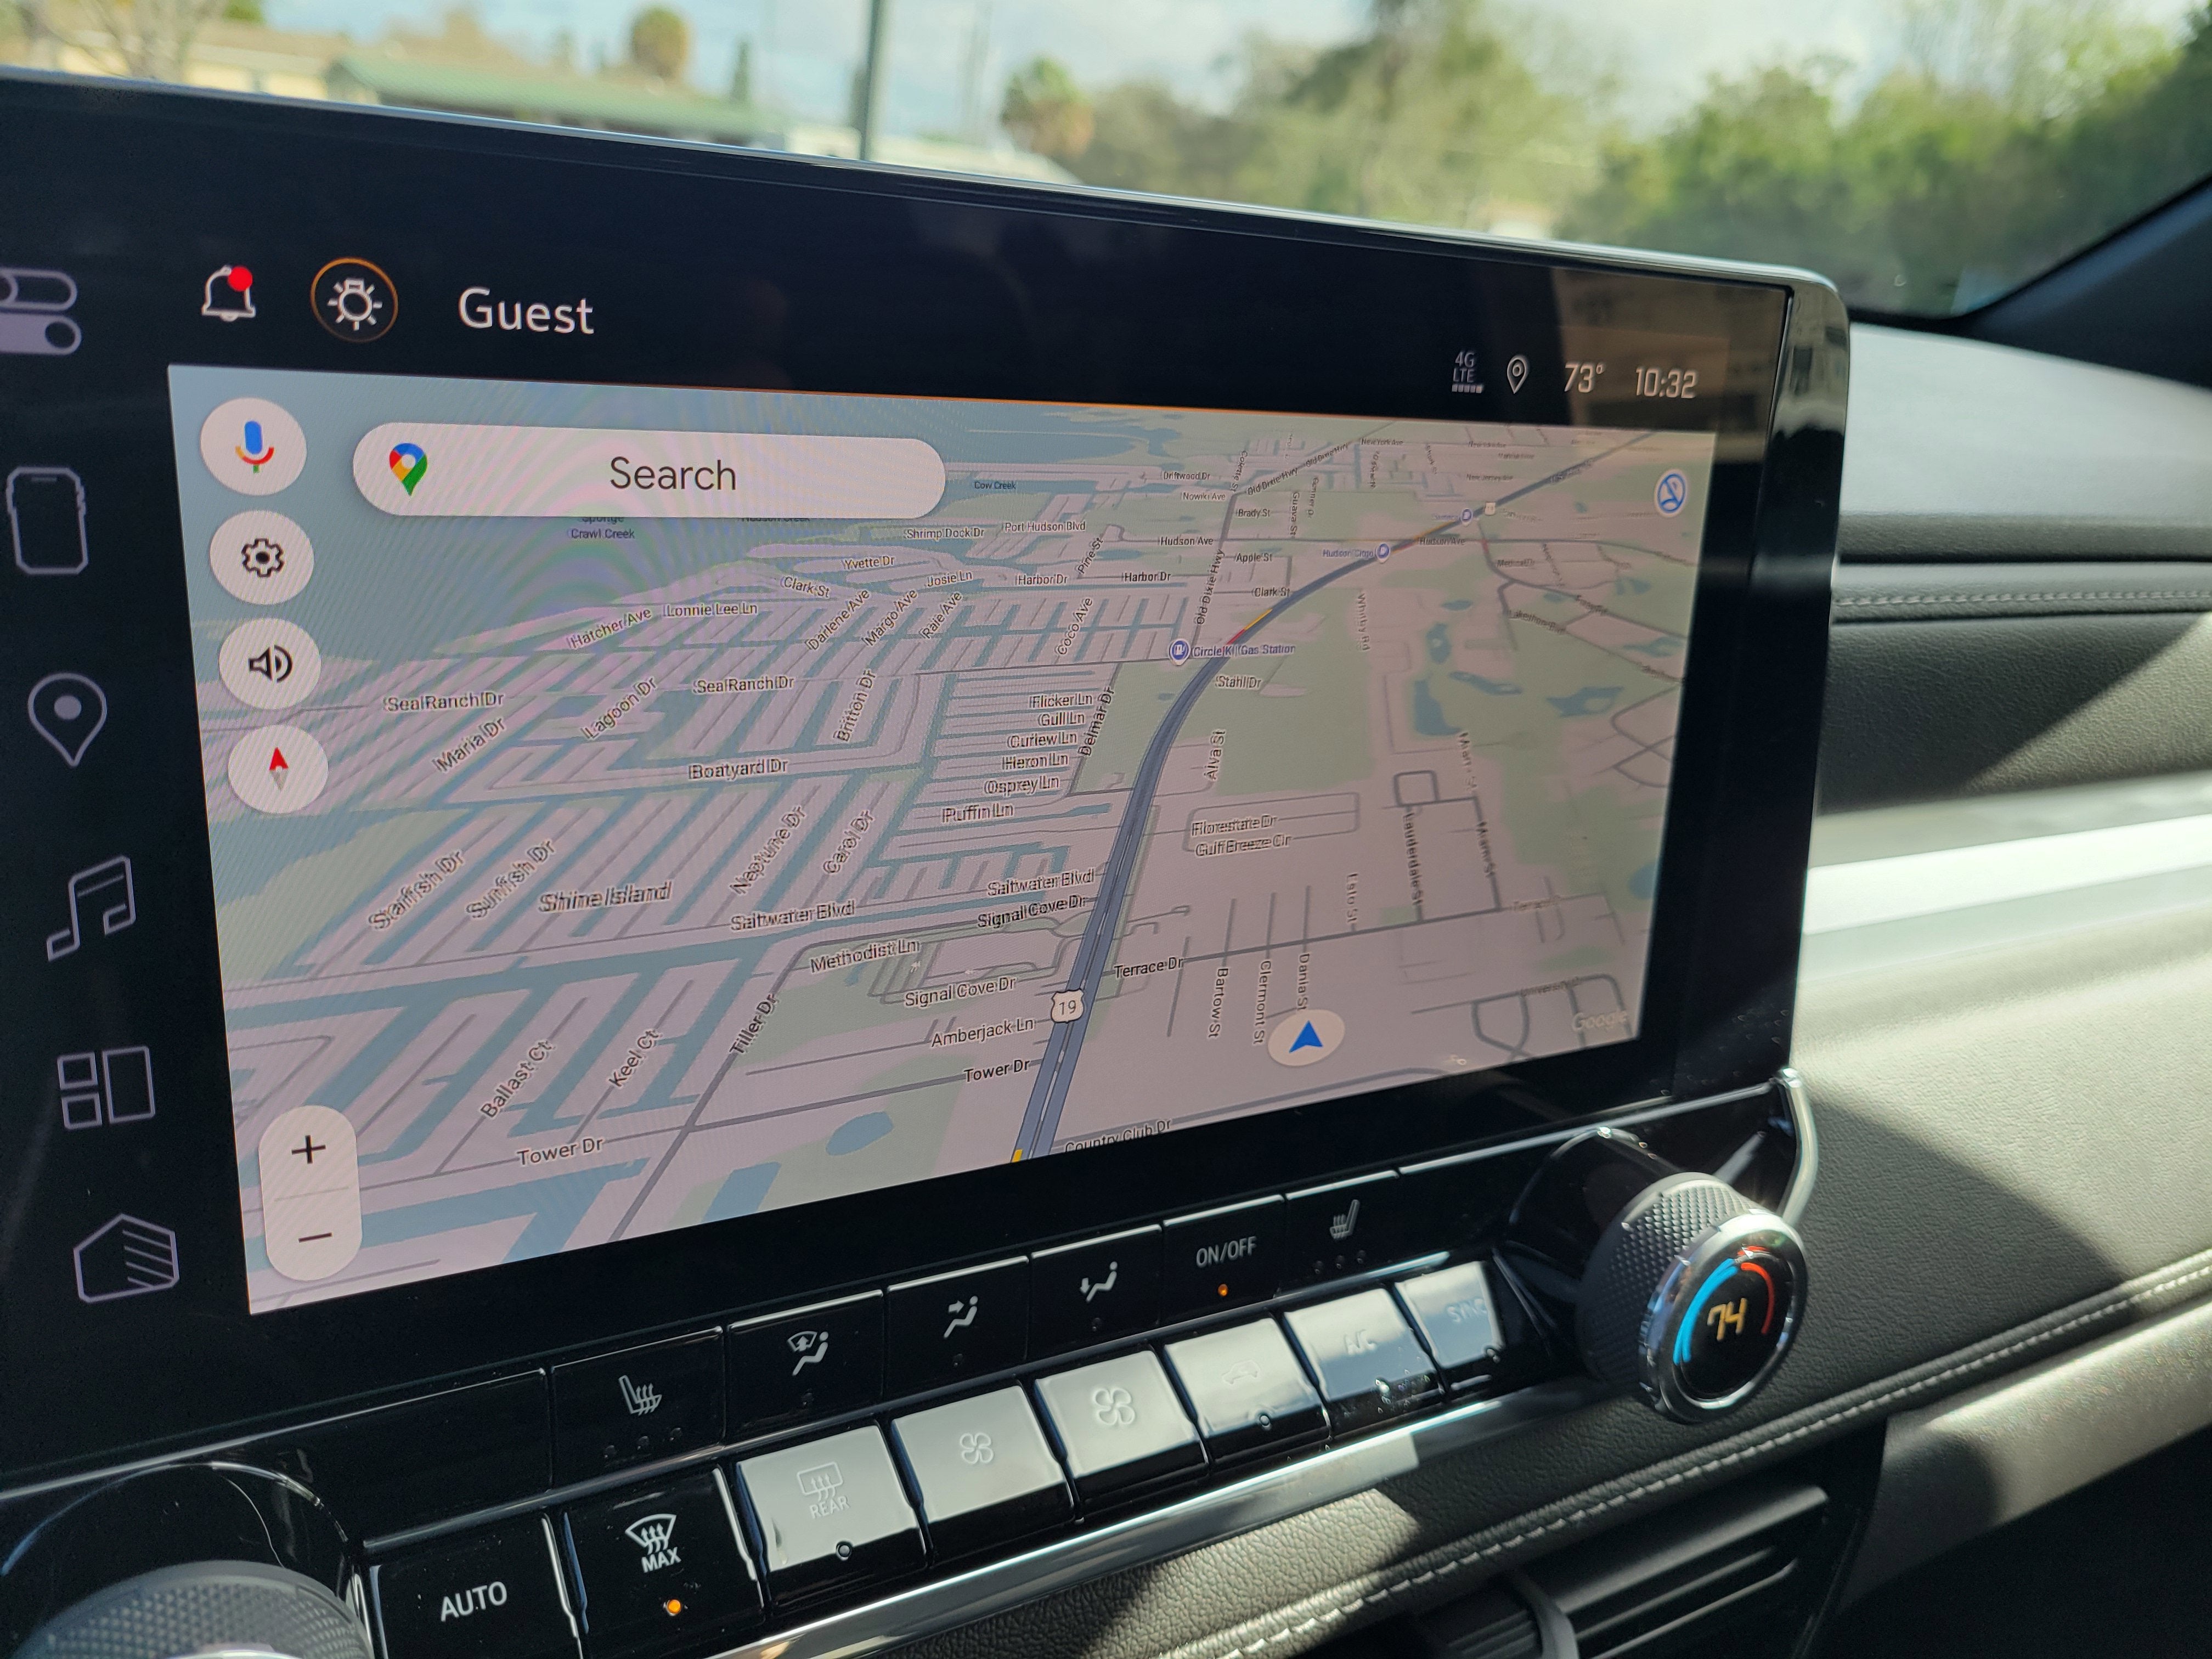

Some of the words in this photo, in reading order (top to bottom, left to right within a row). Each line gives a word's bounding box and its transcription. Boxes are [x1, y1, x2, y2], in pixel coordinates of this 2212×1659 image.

[459, 287, 594, 335] Guest
[1455, 351, 1475, 366] 4G
[1453, 368, 1475, 383] LTE
[1635, 366, 1698, 399] 10:32
[610, 456, 736, 490] Search
[1163, 472, 1200, 481] Driftwood
[1248, 486, 1261, 495] Old
[1262, 476, 1280, 490] Dixie
[1282, 467, 1299, 481] Hwy
[994, 481, 1016, 489] Creek
[1238, 509, 1260, 518] Brady
[1290, 492, 1300, 522] Guava
[571, 528, 601, 539] Crawl
[605, 528, 635, 539] Creek
[907, 528, 942, 539] Shrimp
[945, 528, 971, 538] Dock
[974, 528, 985, 537] Dr
[1006, 523, 1024, 532] Port
[1028, 522, 1063, 532] Hudson
[1066, 522, 1086, 531] Blvd
[1290, 526, 1297, 536] St
[1161, 537, 1195, 546] Hudson
[1197, 537, 1214, 545] Ave
[845, 557, 880, 569] Yvette
[883, 555, 895, 567] Dr
[1077, 550, 1096, 574] Pine
[1093, 537, 1104, 551] St
[1209, 549, 1226, 574] Hwy
[1236, 554, 1260, 563] Apple
[1262, 553, 1272, 562] St
[784, 576, 814, 594] Clark
[816, 585, 831, 597] St
[927, 573, 957, 587] Josie
[959, 571, 972, 582] Ln
[1018, 574, 1052, 585] Harbor
[1056, 574, 1068, 585] Dr
[1125, 572, 1158, 582] Harbor
[1160, 571, 1171, 581] Dr
[1201, 576, 1216, 605] Dixie
[1254, 588, 1277, 597] Clark
[1280, 588, 1290, 596] St
[667, 604, 711, 617] Lonnie
[716, 604, 738, 616] Lee
[741, 604, 759, 615] Ln
[809, 605, 850, 651] Darlene
[848, 589, 871, 612] Ave
[866, 609, 898, 647] Margo
[895, 589, 918, 611] Ave
[1195, 606, 1208, 626] Old
[571, 620, 623, 650] Hatcher
[626, 607, 652, 625] Ave
[1057, 622, 1079, 656] Coco
[1075, 596, 1093, 623] Ave
[1193, 646, 1222, 657] Circle
[1224, 646, 1233, 656] K
[1240, 646, 1259, 656] Gas
[1262, 645, 1295, 655] Station
[729, 677, 772, 691] Ranch
[777, 675, 794, 689] Dr
[1218, 676, 1246, 689] Stahl
[1249, 677, 1262, 689] Dr
[425, 693, 479, 710] Ranch
[485, 692, 504, 706] Dr
[585, 693, 640, 741] Lagoon
[636, 677, 658, 698] Dr
[836, 691, 867, 742] Britton
[859, 670, 877, 690] Dr
[1032, 695, 1074, 708] Flicker
[1079, 693, 1092, 706] Ln
[1041, 714, 1066, 726] Gull
[1070, 713, 1085, 724] Ln
[437, 732, 487, 773] Maria
[483, 717, 506, 739] Dr
[1010, 733, 1058, 748] Curlew
[1062, 732, 1077, 743] Ln
[1211, 730, 1226, 746] St
[691, 759, 764, 782] Boatyard
[769, 758, 788, 772] Dr
[1005, 756, 1048, 770] Heron
[1052, 753, 1069, 766] Ln
[1206, 747, 1222, 781] Alva
[987, 780, 1037, 798] Osprey
[1042, 776, 1059, 789] Ln
[851, 809, 874, 832] Dr
[944, 805, 990, 822] Puffin
[994, 803, 1014, 817] Ln
[1262, 815, 1278, 828] Dr
[530, 839, 556, 864] Dr
[730, 828, 792, 896] Neptune
[781, 805, 806, 829] Dr
[1195, 840, 1226, 857] Gulf
[1227, 837, 1272, 853] Breeze
[1273, 834, 1291, 847] Cir
[437, 849, 465, 876] Dr
[988, 876, 1059, 897] Saltwater
[1062, 868, 1094, 887] Blvd
[538, 891, 602, 912] Shine
[606, 881, 672, 907] Island
[731, 909, 815, 931] Saltwater
[817, 900, 855, 920] Blvd
[978, 907, 1028, 929] Signal
[1029, 899, 1067, 917] Cove
[1069, 894, 1087, 909] Dr
[811, 944, 894, 974] Methodist
[898, 939, 921, 954] Ln
[1114, 961, 1164, 979] Terrace
[1168, 957, 1184, 970] Dr
[905, 986, 953, 1008] Signal
[957, 980, 995, 998] Cove
[998, 977, 1017, 992] Dr
[1211, 967, 1229, 1021] Bartow
[1255, 960, 1273, 1027] Clermont
[1058, 1000, 1076, 1016] 19
[1297, 997, 1309, 1012] St
[730, 1017, 765, 1054] Tiller
[757, 992, 780, 1015] Dr
[931, 1020, 1011, 1048] Amberjack
[1017, 1019, 1034, 1032] Ln
[1208, 1023, 1221, 1039] St
[1253, 1029, 1266, 1046] St
[609, 1051, 642, 1088] Keel
[637, 1029, 659, 1051] Ct
[481, 1062, 533, 1119] Ballast
[529, 1040, 555, 1063] Ct
[964, 1064, 1010, 1082] Tower
[1013, 1059, 1031, 1073] Dr
[1123, 1124, 1153, 1141] Club
[1156, 1119, 1172, 1132] Dr
[517, 1142, 577, 1166] Tower
[582, 1137, 604, 1154] Dr
[1196, 1236, 1257, 1268] ON/OFF
[1707, 1297, 1747, 1341] 74
[810, 1495, 851, 1519] REAR
[641, 1547, 682, 1573] MAX
[441, 1581, 507, 1623] AUTO
